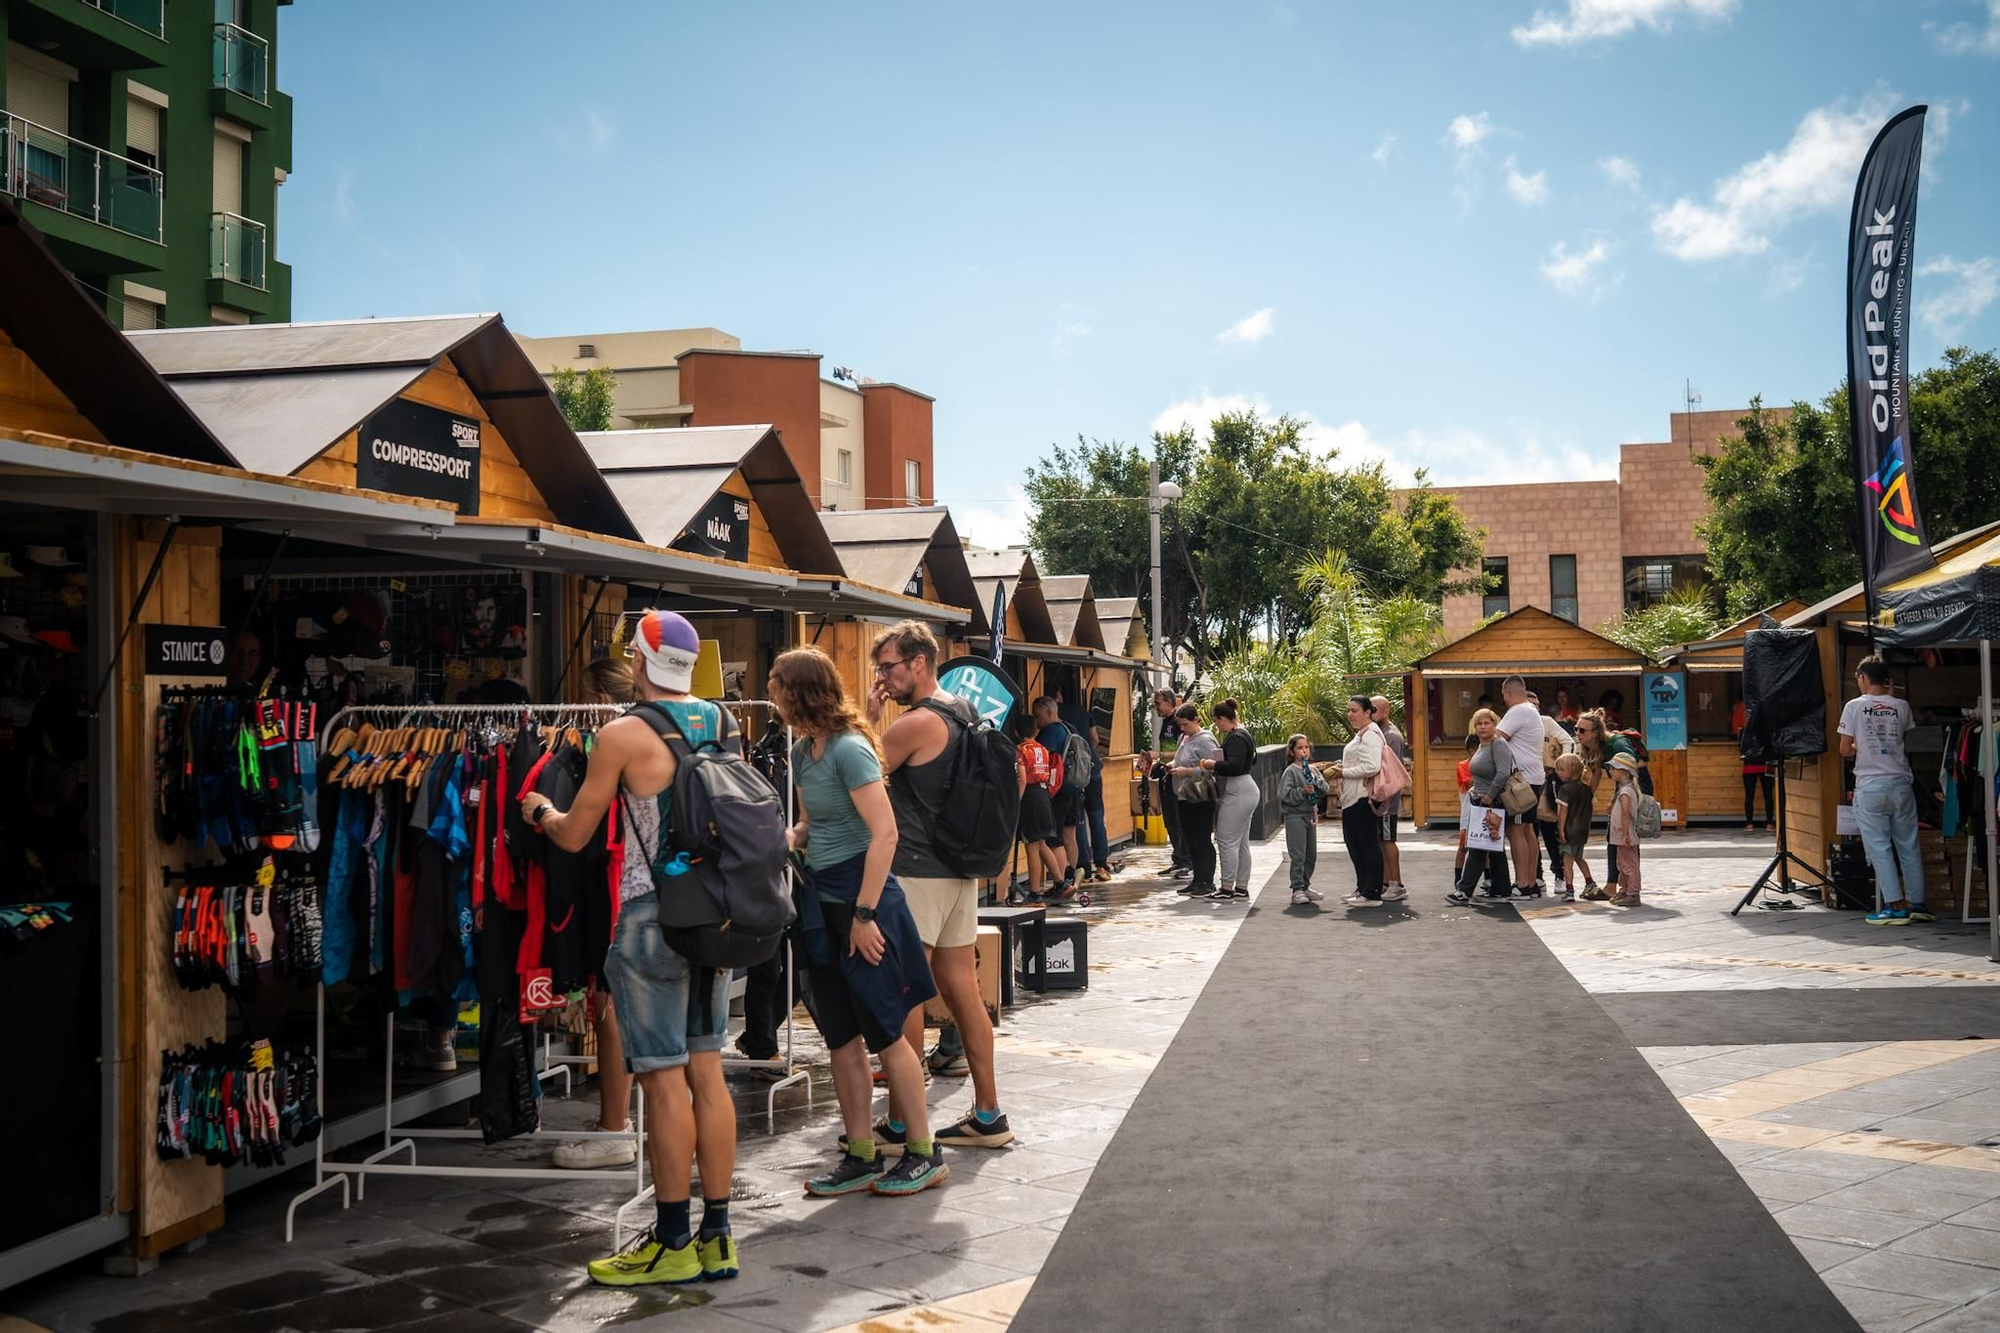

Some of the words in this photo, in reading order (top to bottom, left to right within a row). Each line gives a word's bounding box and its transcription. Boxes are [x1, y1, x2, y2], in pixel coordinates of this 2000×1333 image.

[1865, 204, 1896, 333] Peak
[1894, 279, 1905, 338] RUNNING
[1867, 346, 1889, 433] Old
[1892, 349, 1901, 418] MOUNTAIN
[452, 424, 479, 440] SPORT
[372, 438, 471, 479] COMPRESSPORT
[707, 516, 730, 542] NÄAK
[1904, 608, 1922, 623] FUERZA
[1944, 601, 1966, 616] EVENTO
[162, 641, 206, 661] STANCE
